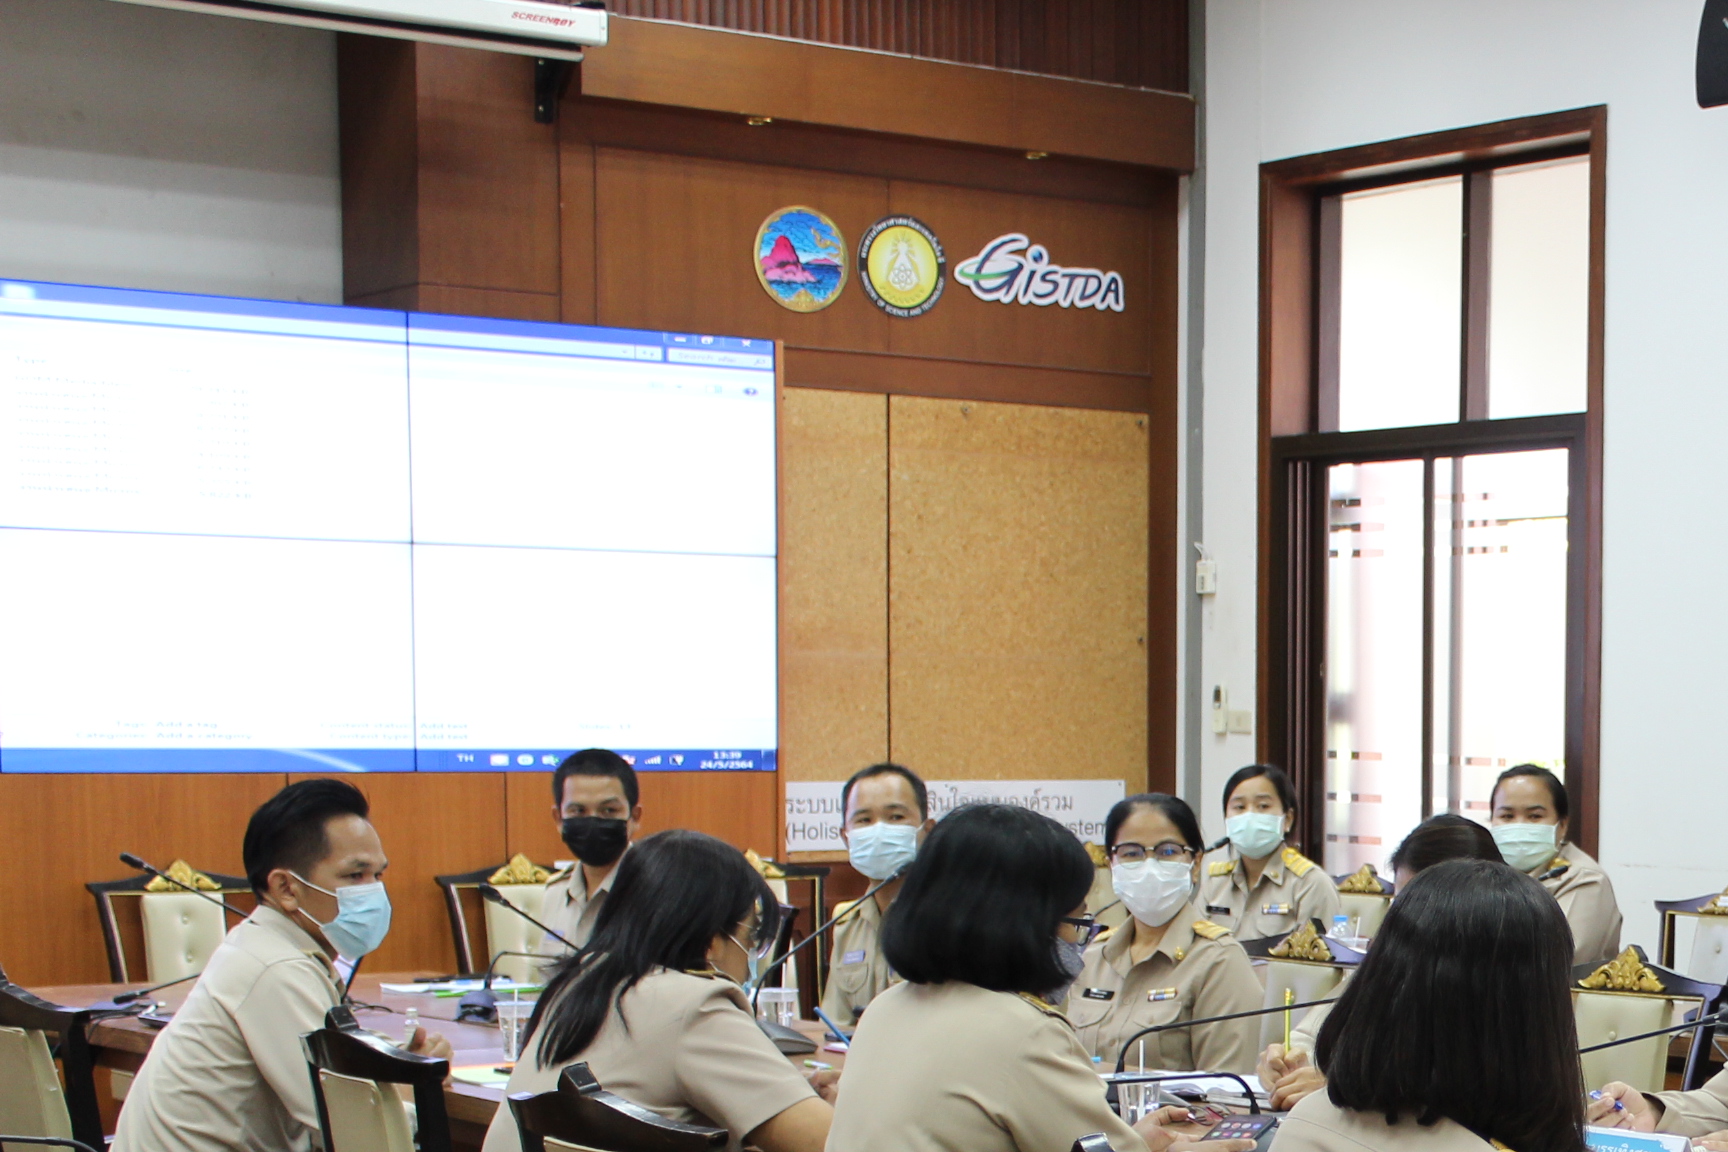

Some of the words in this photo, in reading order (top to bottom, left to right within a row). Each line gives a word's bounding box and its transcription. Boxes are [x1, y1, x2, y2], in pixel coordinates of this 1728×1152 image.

[885, 305, 909, 317] SCIENCE
[909, 307, 922, 317] AND
[457, 754, 474, 763] TH
